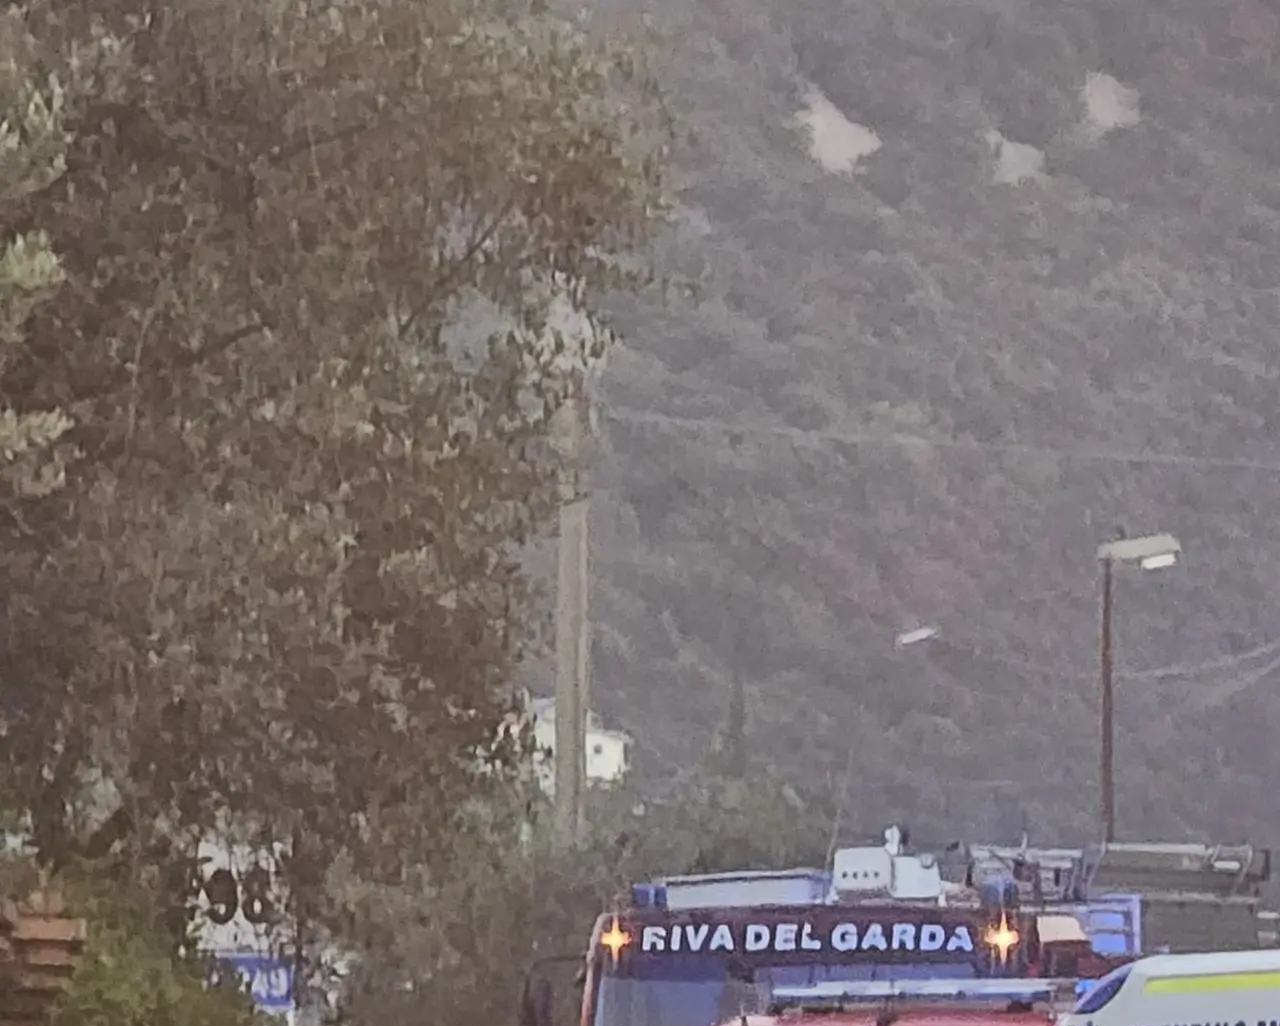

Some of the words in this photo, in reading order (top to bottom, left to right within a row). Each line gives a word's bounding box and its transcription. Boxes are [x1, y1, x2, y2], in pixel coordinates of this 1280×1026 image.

[642, 924, 735, 951] RIVA
[745, 924, 822, 951] DEL
[831, 923, 974, 951] GARDA
